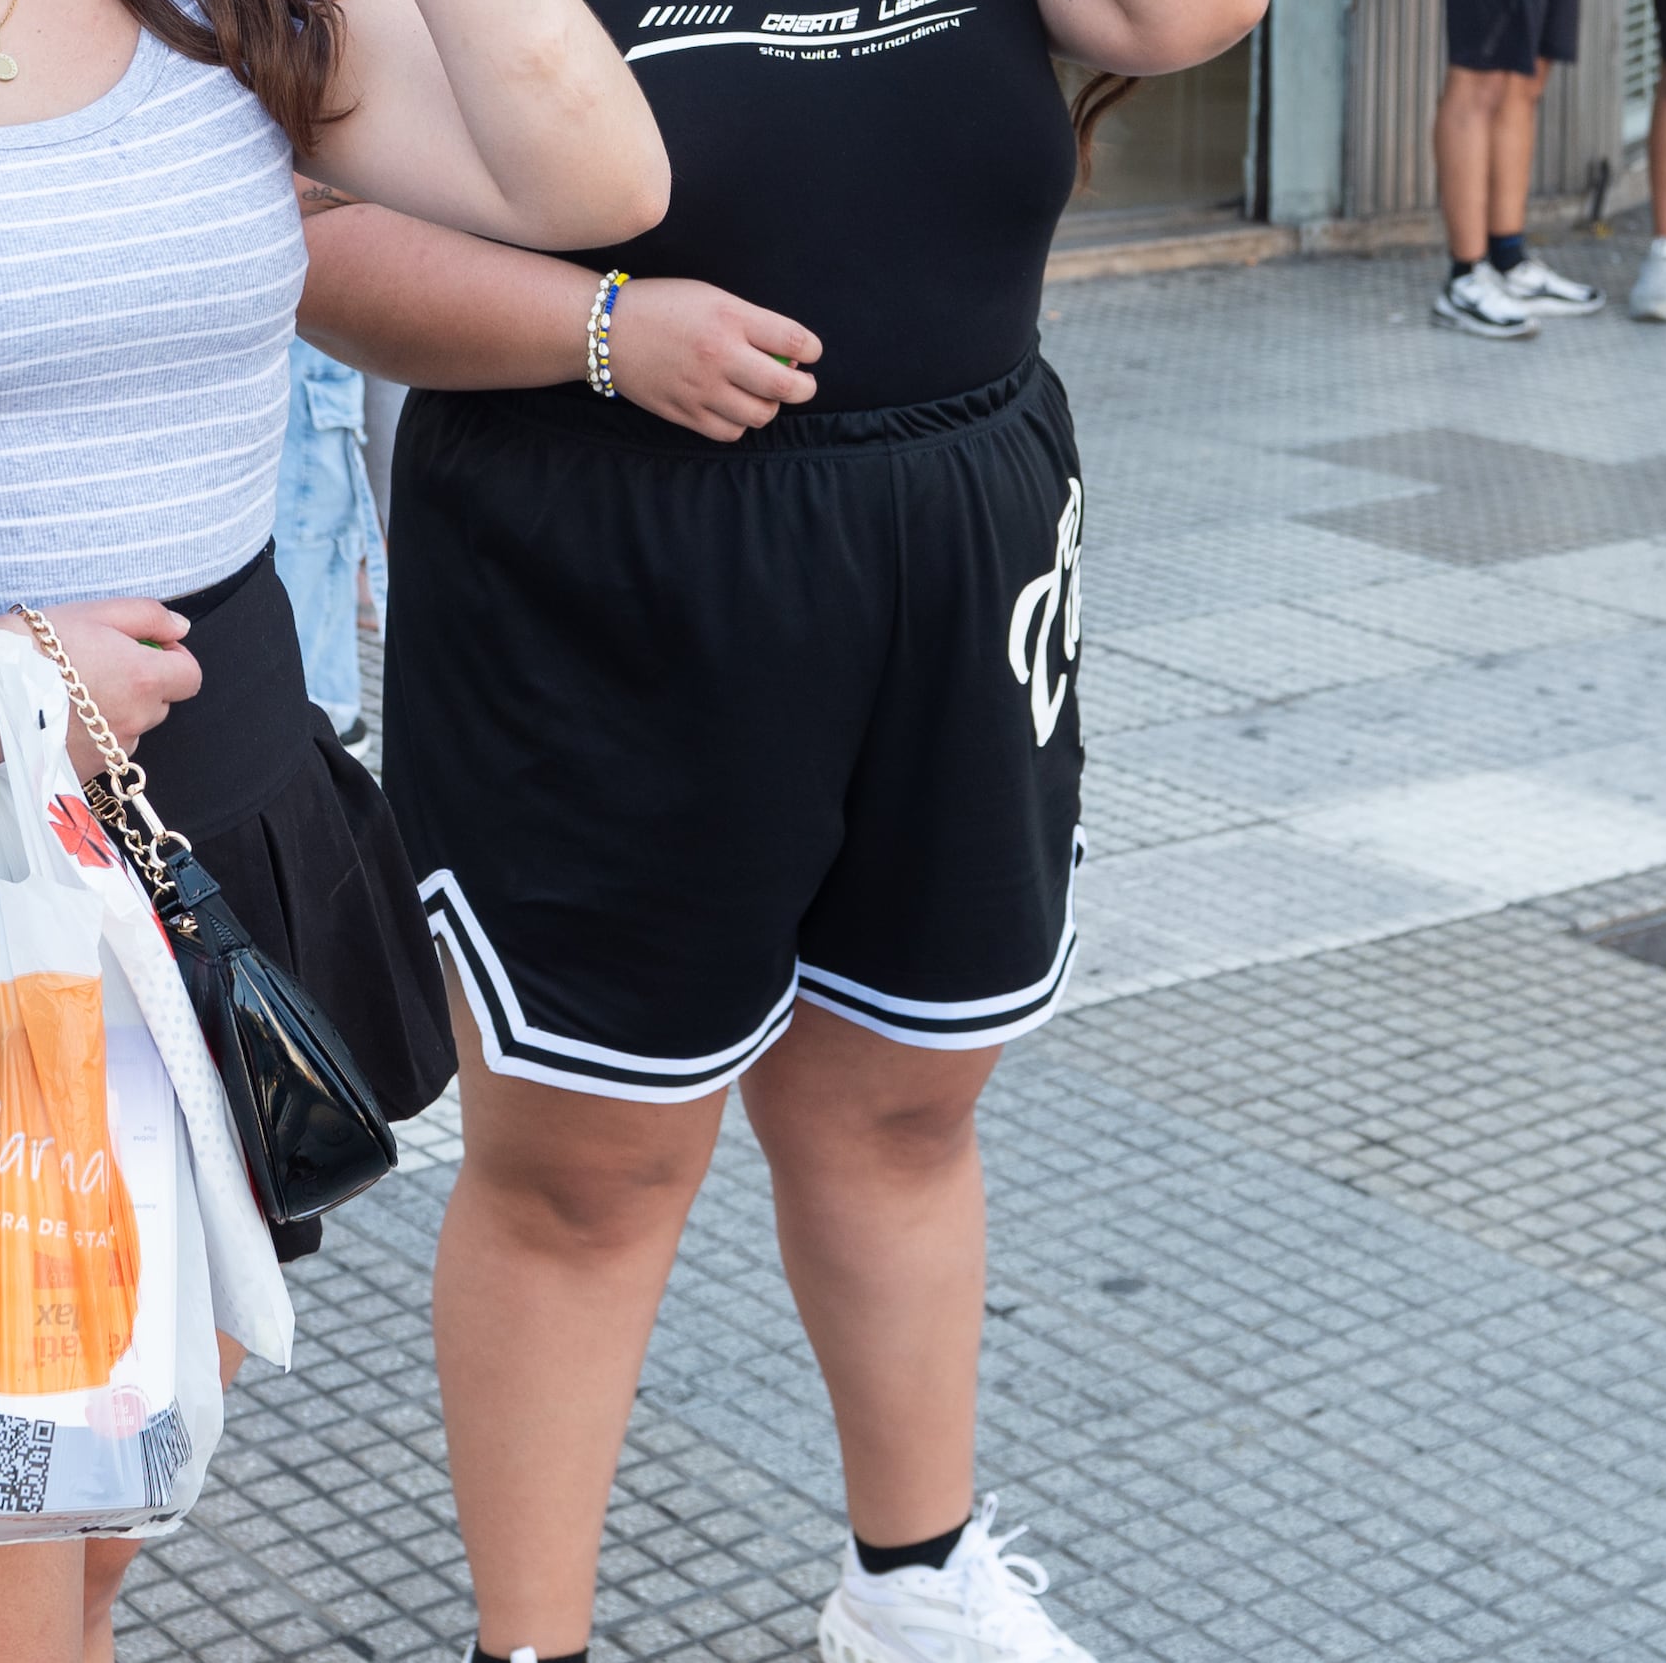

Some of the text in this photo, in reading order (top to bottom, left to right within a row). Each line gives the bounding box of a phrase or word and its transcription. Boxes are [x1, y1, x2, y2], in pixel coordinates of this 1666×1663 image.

[760, 7, 860, 34] CREATE
[759, 46, 796, 61] stay
[800, 48, 842, 61] wild.
[38, 1218, 69, 1239] DE
